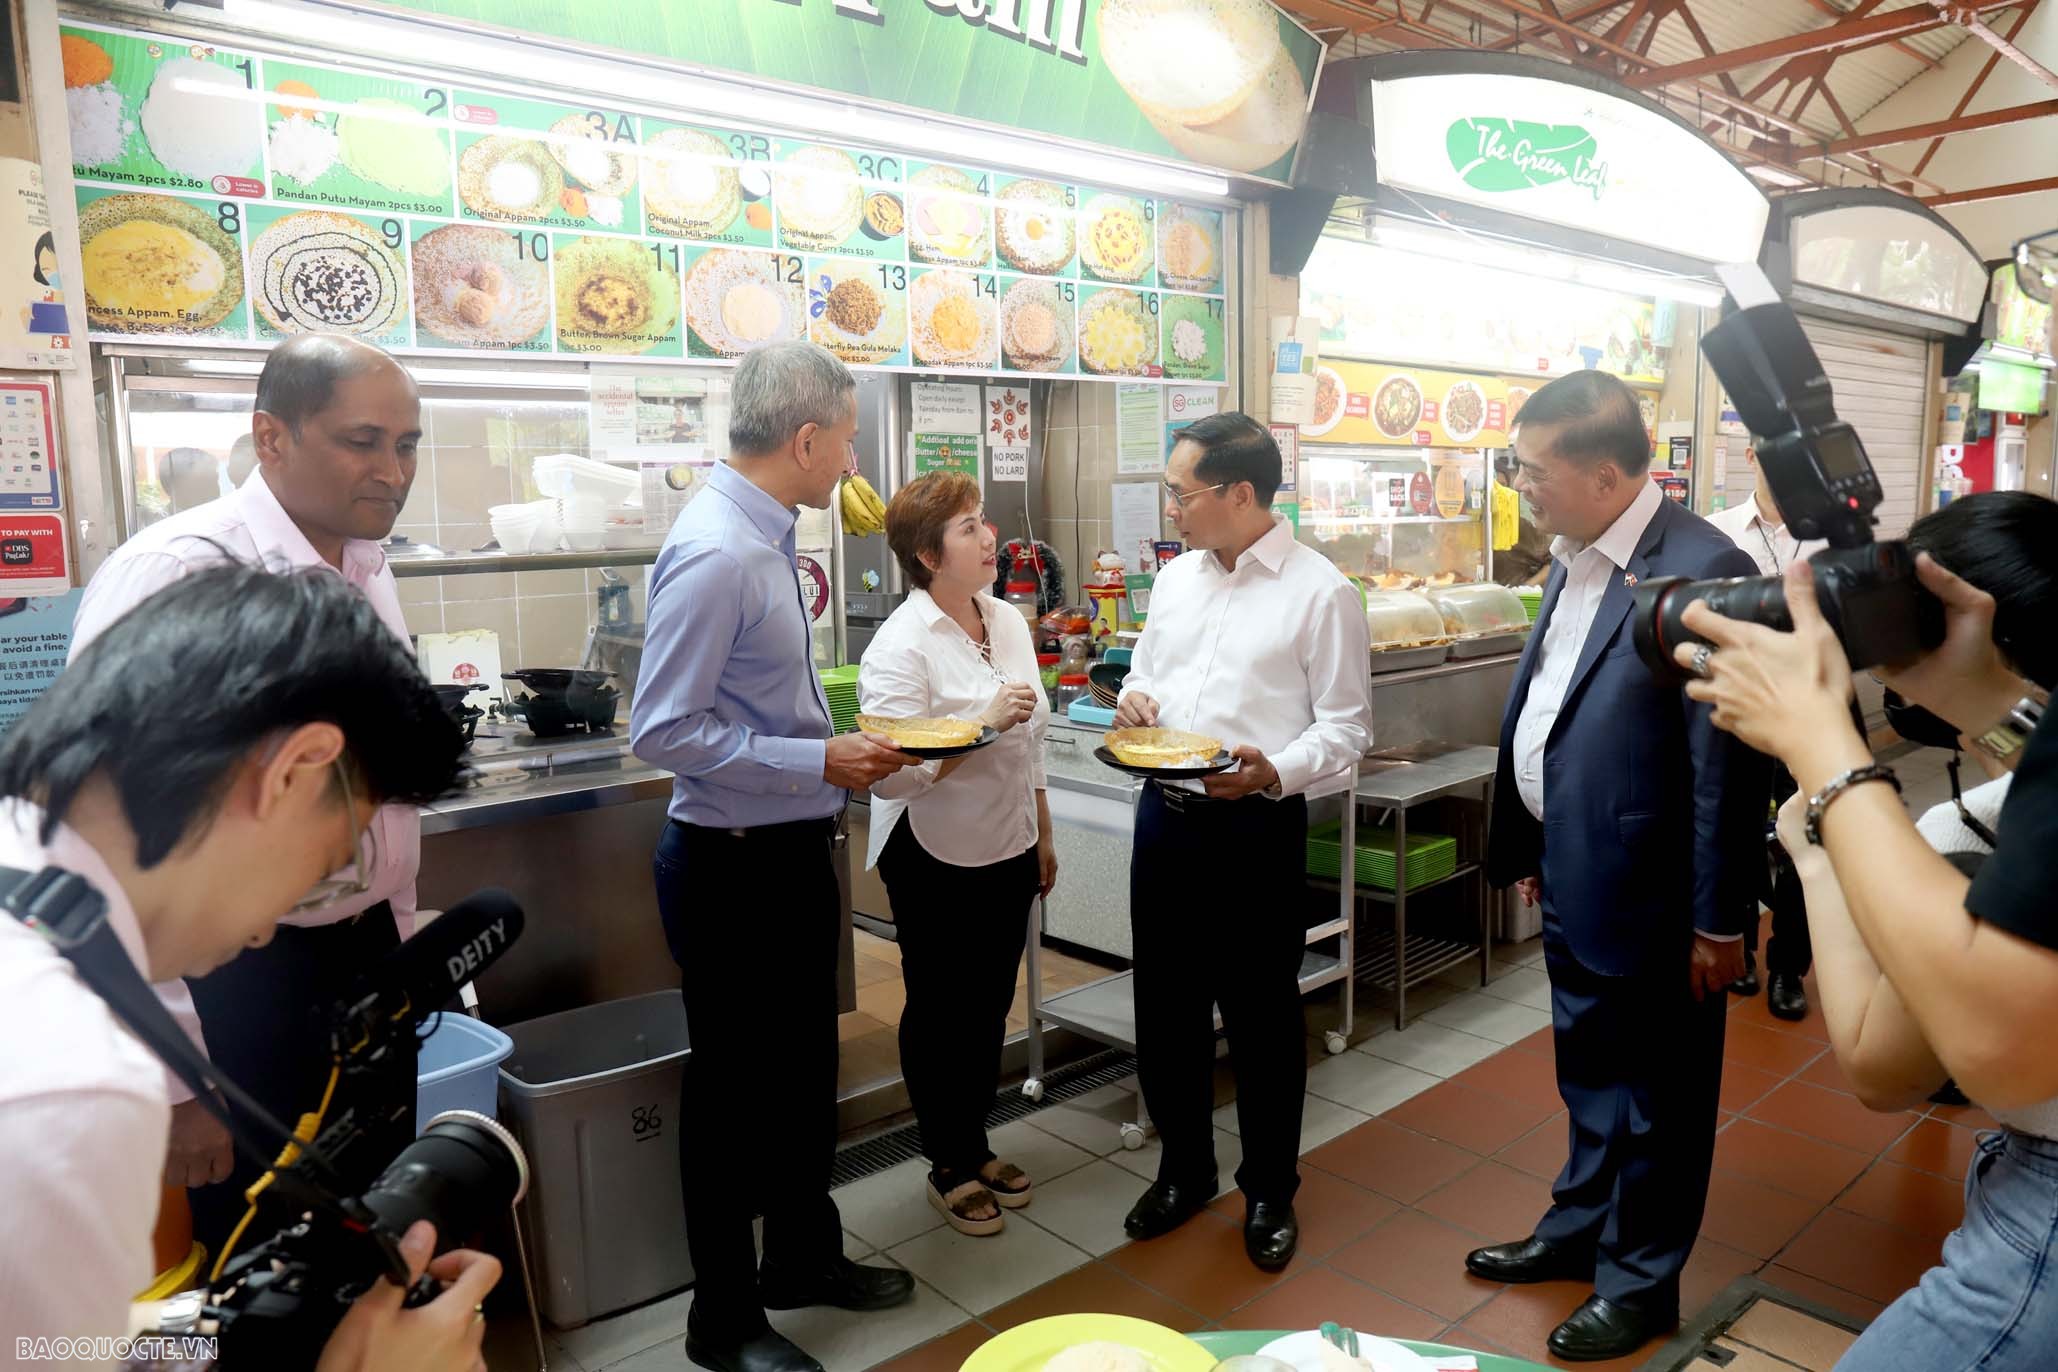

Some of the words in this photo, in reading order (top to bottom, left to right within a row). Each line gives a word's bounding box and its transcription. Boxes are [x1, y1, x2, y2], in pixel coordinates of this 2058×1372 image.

[236, 60, 252, 90] 1
[424, 88, 447, 117] 2
[584, 111, 637, 145] 3A
[1476, 124, 1509, 160] The
[1510, 138, 1568, 177] Green
[1570, 155, 1609, 201] Leaf
[89, 167, 135, 183] Mayam
[138, 174, 166, 187] 2pcs
[169, 176, 204, 189] $2.80
[976, 174, 990, 197] 4
[277, 188, 318, 201] Pandan
[320, 192, 346, 204] Putu
[349, 196, 386, 208] Mayam
[389, 200, 411, 213] 2pcs
[414, 203, 443, 213] $3.00
[1064, 187, 1076, 208] 5
[218, 202, 240, 234] 8
[464, 206, 501, 220] Original
[504, 213, 537, 224] Appam
[539, 216, 559, 226] 2pcs
[561, 217, 585, 228] $3.50
[648, 212, 681, 227] Original
[1143, 200, 1154, 221] 6
[381, 218, 402, 249] 9
[648, 225, 684, 238] Coconut
[685, 229, 702, 239] Milk
[704, 232, 721, 242] 2pcs
[723, 233, 744, 243] $3.50
[780, 226, 808, 239] Original
[512, 231, 548, 262] 10
[780, 238, 815, 251] Vegetable
[817, 241, 837, 254] Curry
[650, 242, 679, 273] 11
[771, 255, 803, 284] 12
[879, 265, 906, 291] 13
[973, 274, 997, 299] 14
[1055, 281, 1075, 302] 15
[1138, 291, 1159, 316] 16
[1204, 298, 1223, 319] 17
[178, 309, 202, 322] Egg,
[473, 339, 505, 350] Appam
[525, 341, 549, 351] $3.50
[593, 331, 619, 341] Brown
[622, 333, 645, 344] Sugar
[648, 334, 677, 344] Appam
[577, 344, 602, 353] $3.00
[1187, 397, 1214, 407] CLEAN
[994, 453, 1004, 461] NO
[1005, 453, 1025, 462] PORK
[994, 466, 1005, 474] NO
[1006, 467, 1025, 475] LARD
[31, 528, 53, 536] WITH
[2, 644, 33, 654] avoid
[43, 642, 67, 651] fine.
[14, 635, 39, 644] your
[40, 632, 68, 641] table
[447, 918, 507, 983] DEITY
[632, 1103, 662, 1135] 86
